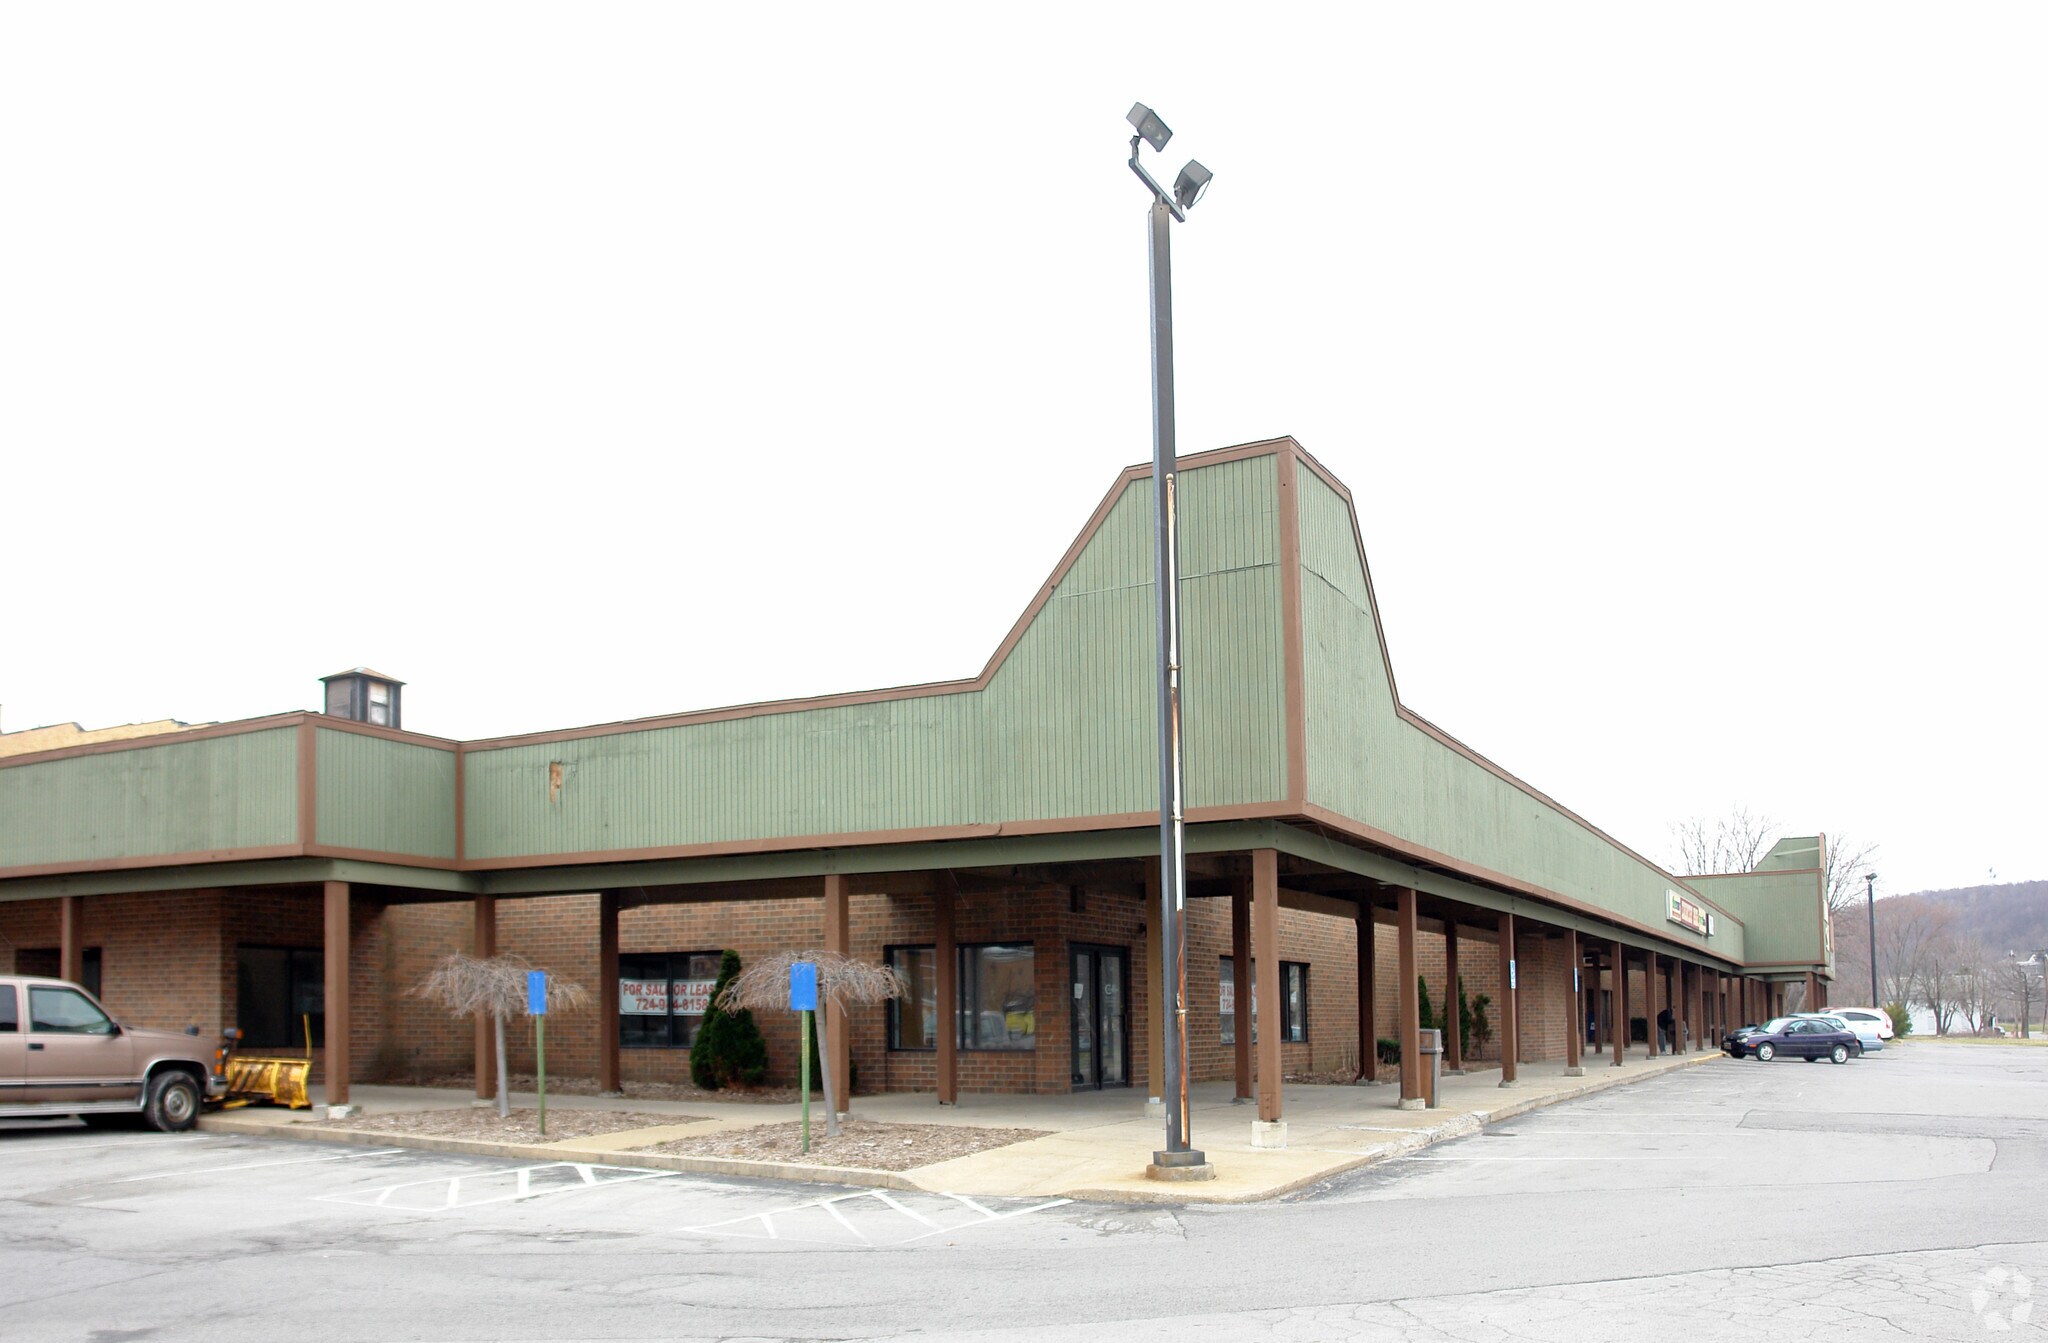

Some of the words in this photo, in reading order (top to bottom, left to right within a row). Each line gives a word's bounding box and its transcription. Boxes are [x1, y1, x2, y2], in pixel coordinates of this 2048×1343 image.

[623, 983, 642, 996] FOR
[645, 984, 668, 996] SAL
[673, 984, 687, 996] OR
[689, 984, 715, 996] LEAS
[636, 998, 708, 1011] 724-94-8158
